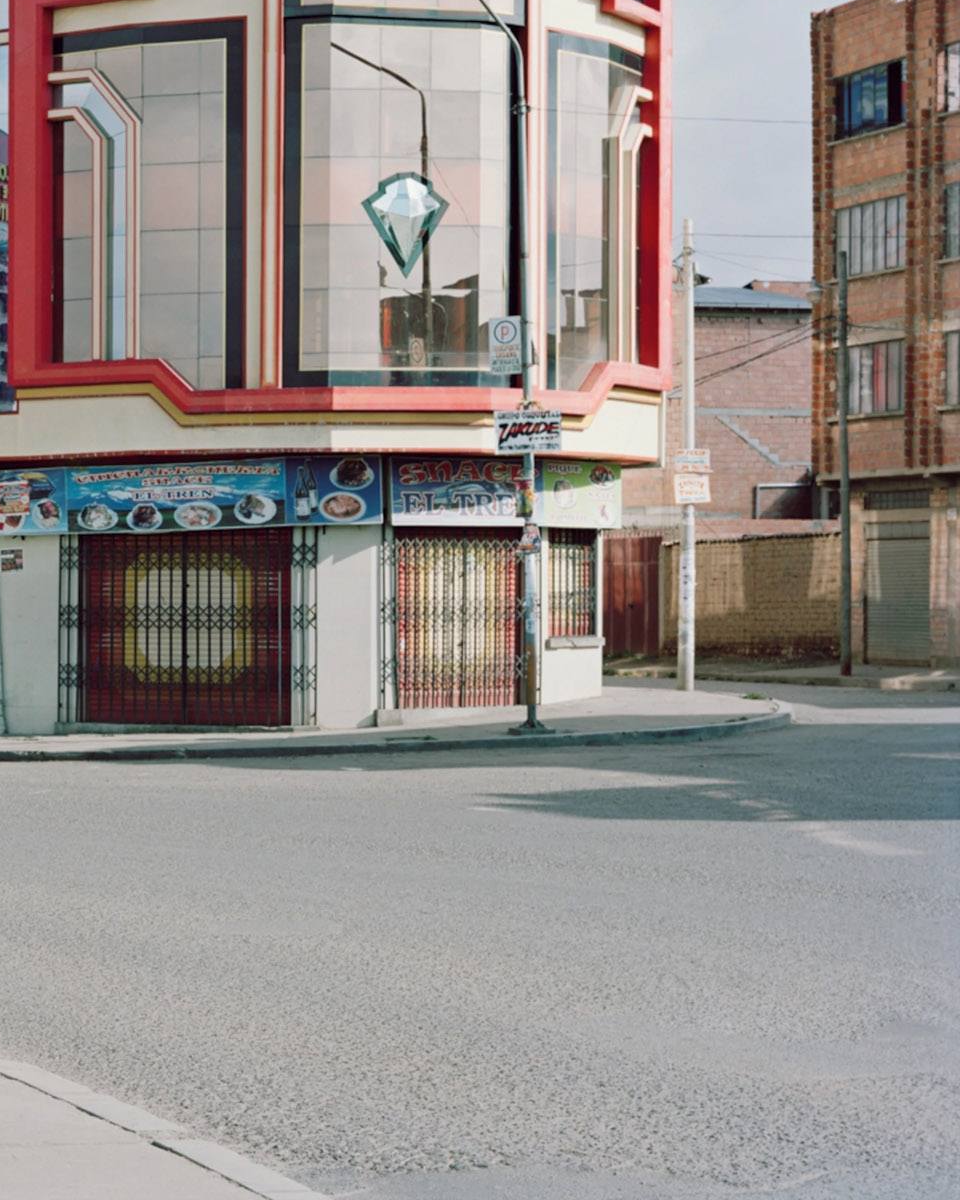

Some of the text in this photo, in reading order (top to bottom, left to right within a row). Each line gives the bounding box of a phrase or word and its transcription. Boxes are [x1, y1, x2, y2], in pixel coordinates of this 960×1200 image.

[166, 489, 214, 499] TREN
[402, 491, 518, 516] EL TRE
